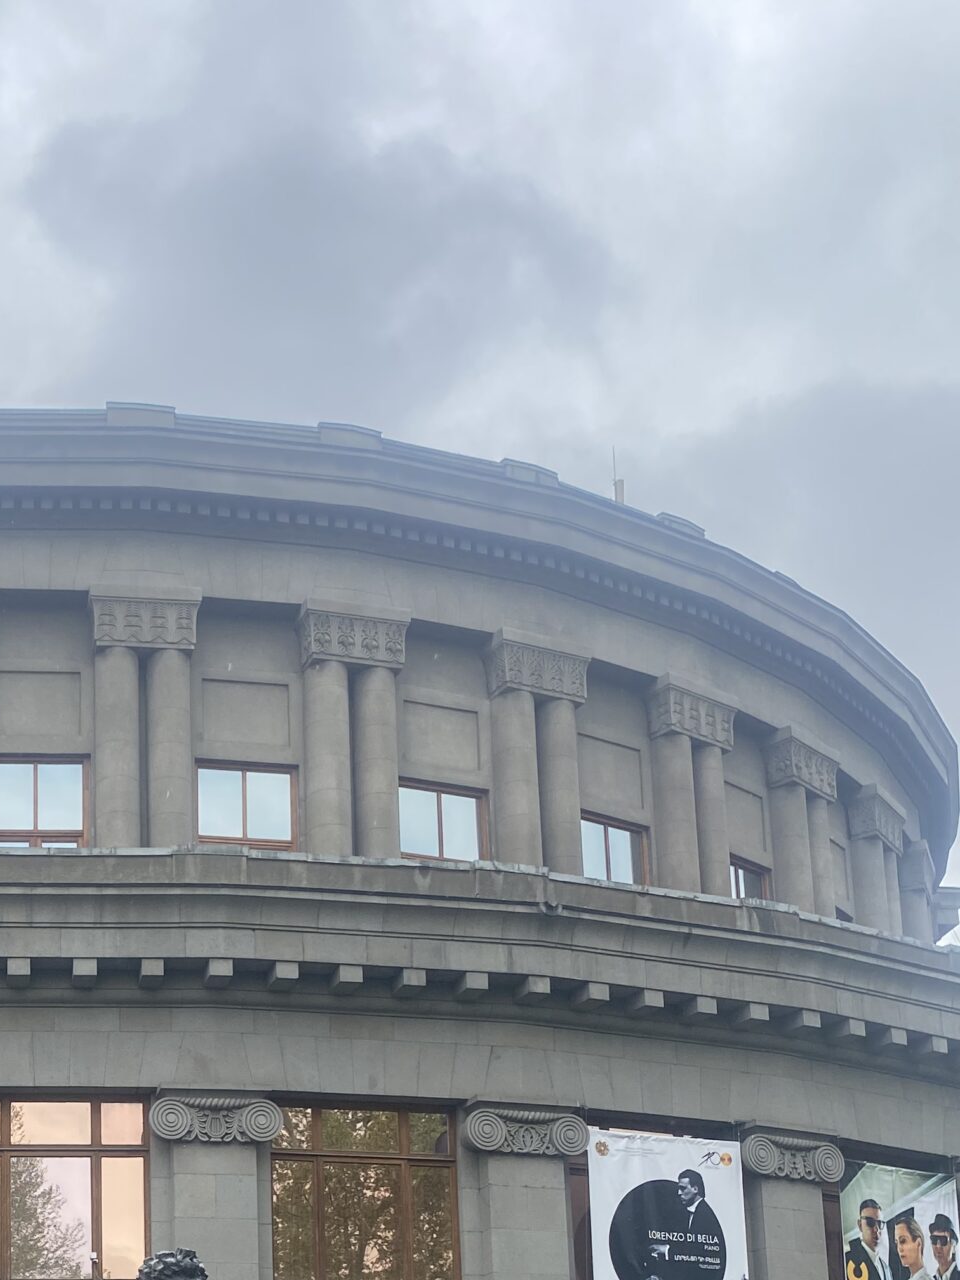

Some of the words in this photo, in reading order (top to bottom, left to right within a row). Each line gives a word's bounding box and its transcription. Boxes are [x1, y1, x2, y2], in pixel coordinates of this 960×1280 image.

[648, 1229, 685, 1242] LORENZO
[687, 1233, 695, 1242] DI
[697, 1234, 719, 1244] BELLA
